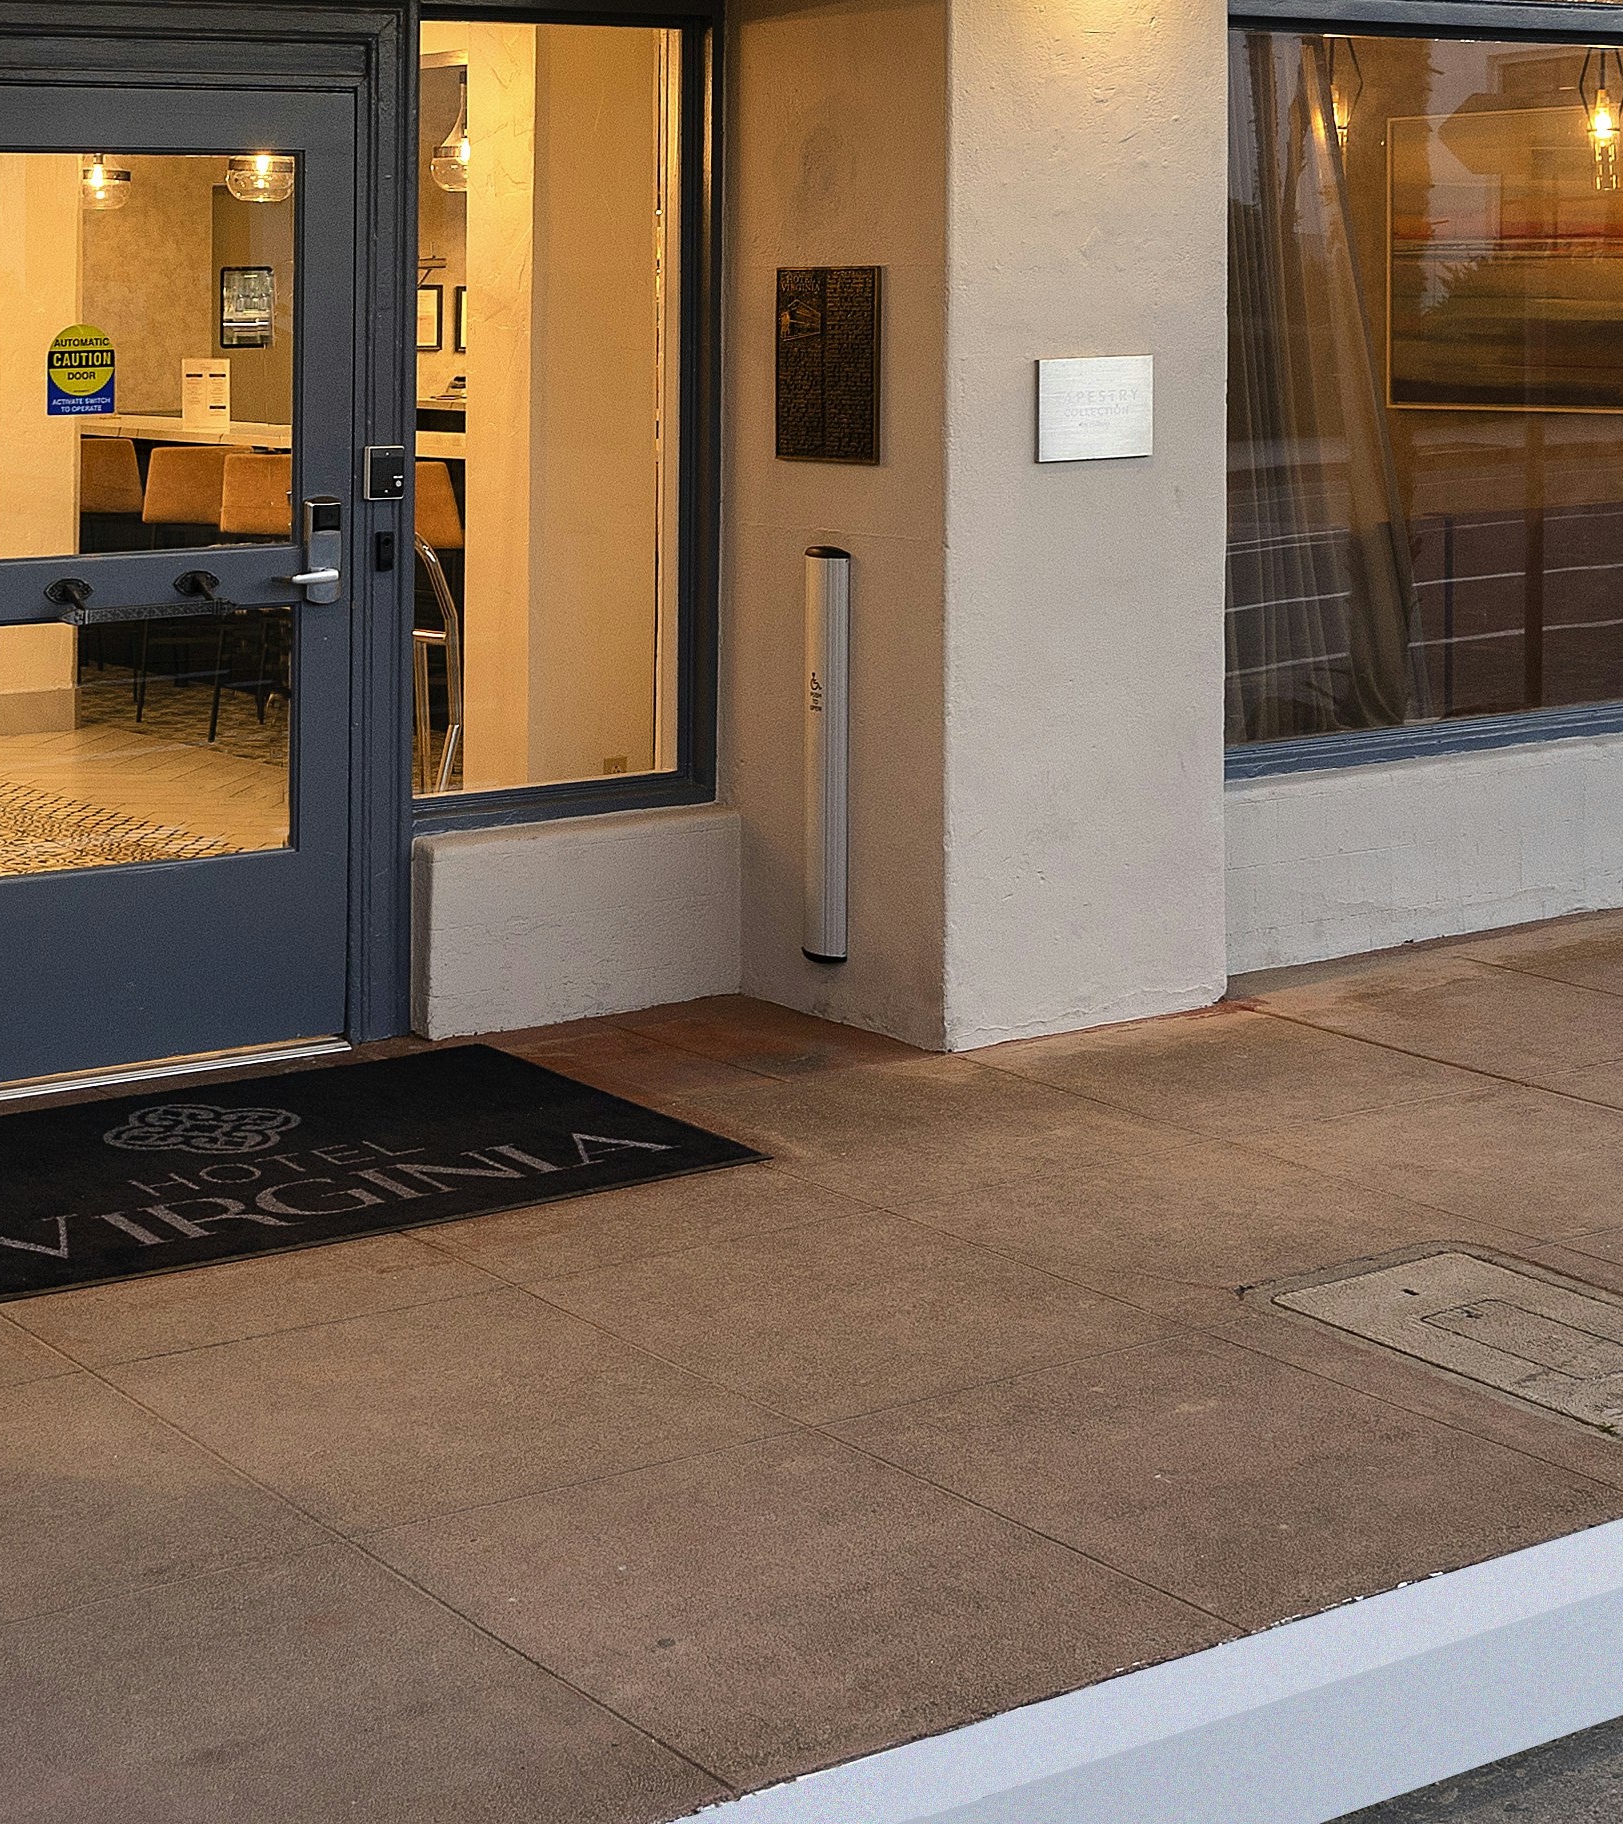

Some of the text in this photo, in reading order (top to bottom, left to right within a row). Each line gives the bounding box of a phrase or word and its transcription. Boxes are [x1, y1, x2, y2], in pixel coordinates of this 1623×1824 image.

[53, 337, 110, 347] AUTOMATIC
[52, 351, 112, 367] CAUTION
[67, 371, 96, 381] DOOR
[1054, 388, 1138, 403] APESTRY
[52, 396, 111, 406] ACTIVATE SWITCH
[60, 404, 103, 413] TO OPERATE
[128, 1138, 426, 1197] HOTEL
